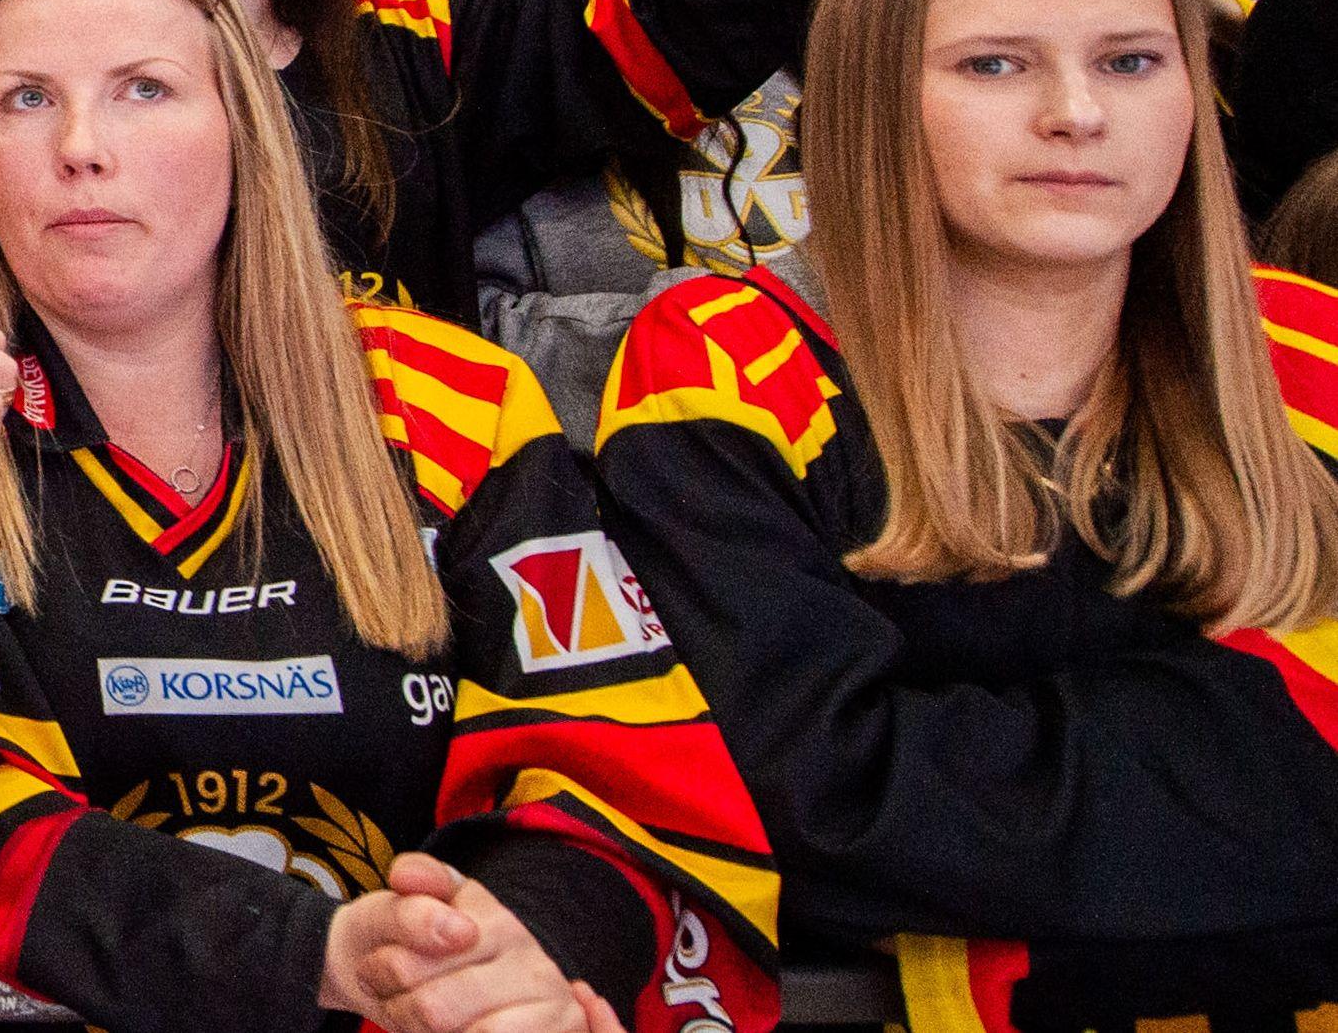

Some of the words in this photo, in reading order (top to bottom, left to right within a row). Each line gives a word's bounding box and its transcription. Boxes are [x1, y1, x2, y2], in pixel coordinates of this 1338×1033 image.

[338, 270, 383, 303] 12
[160, 666, 334, 701] KORSNÄS
[169, 769, 288, 816] 1912
